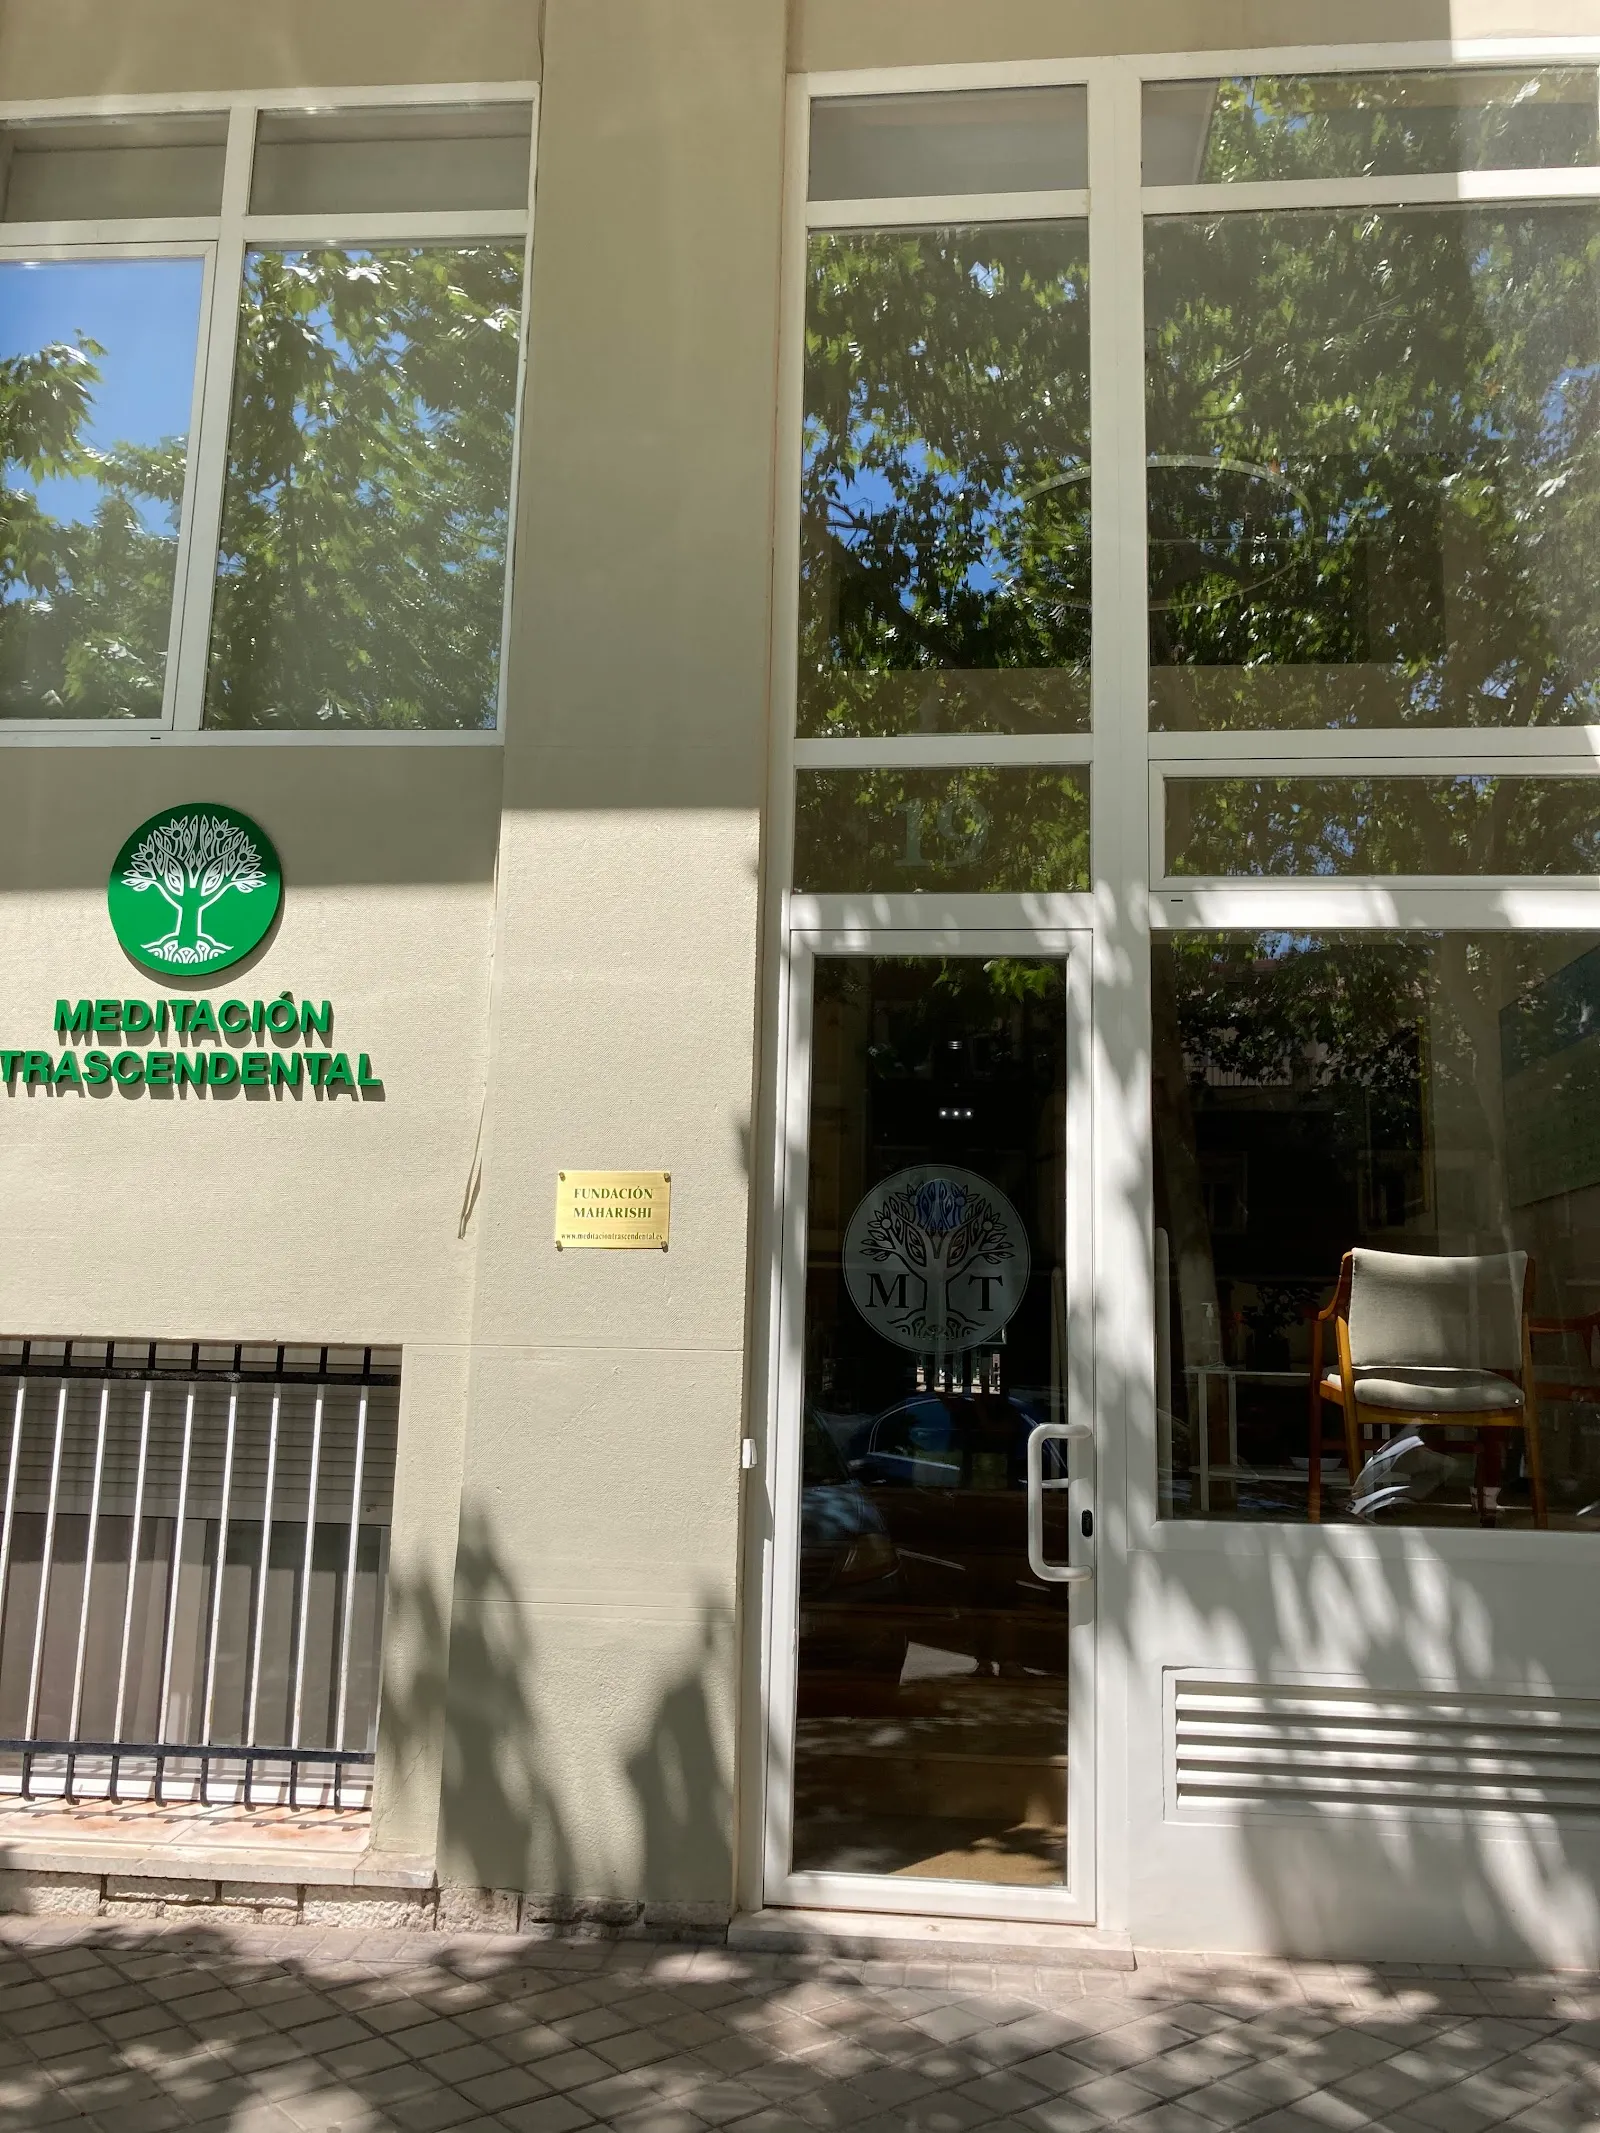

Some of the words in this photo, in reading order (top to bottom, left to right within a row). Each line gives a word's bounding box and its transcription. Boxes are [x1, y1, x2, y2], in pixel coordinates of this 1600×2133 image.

[54, 991, 332, 1033] MEDITACIÓN
[0, 1050, 383, 1087] TRASCENDENTAL
[574, 1186, 653, 1199] FUNDACIÓN
[573, 1207, 652, 1218] MAHARISHI
[561, 1232, 663, 1240] www.meditaciontrascendental.es
[865, 1273, 910, 1309] M
[968, 1275, 1004, 1312] T
